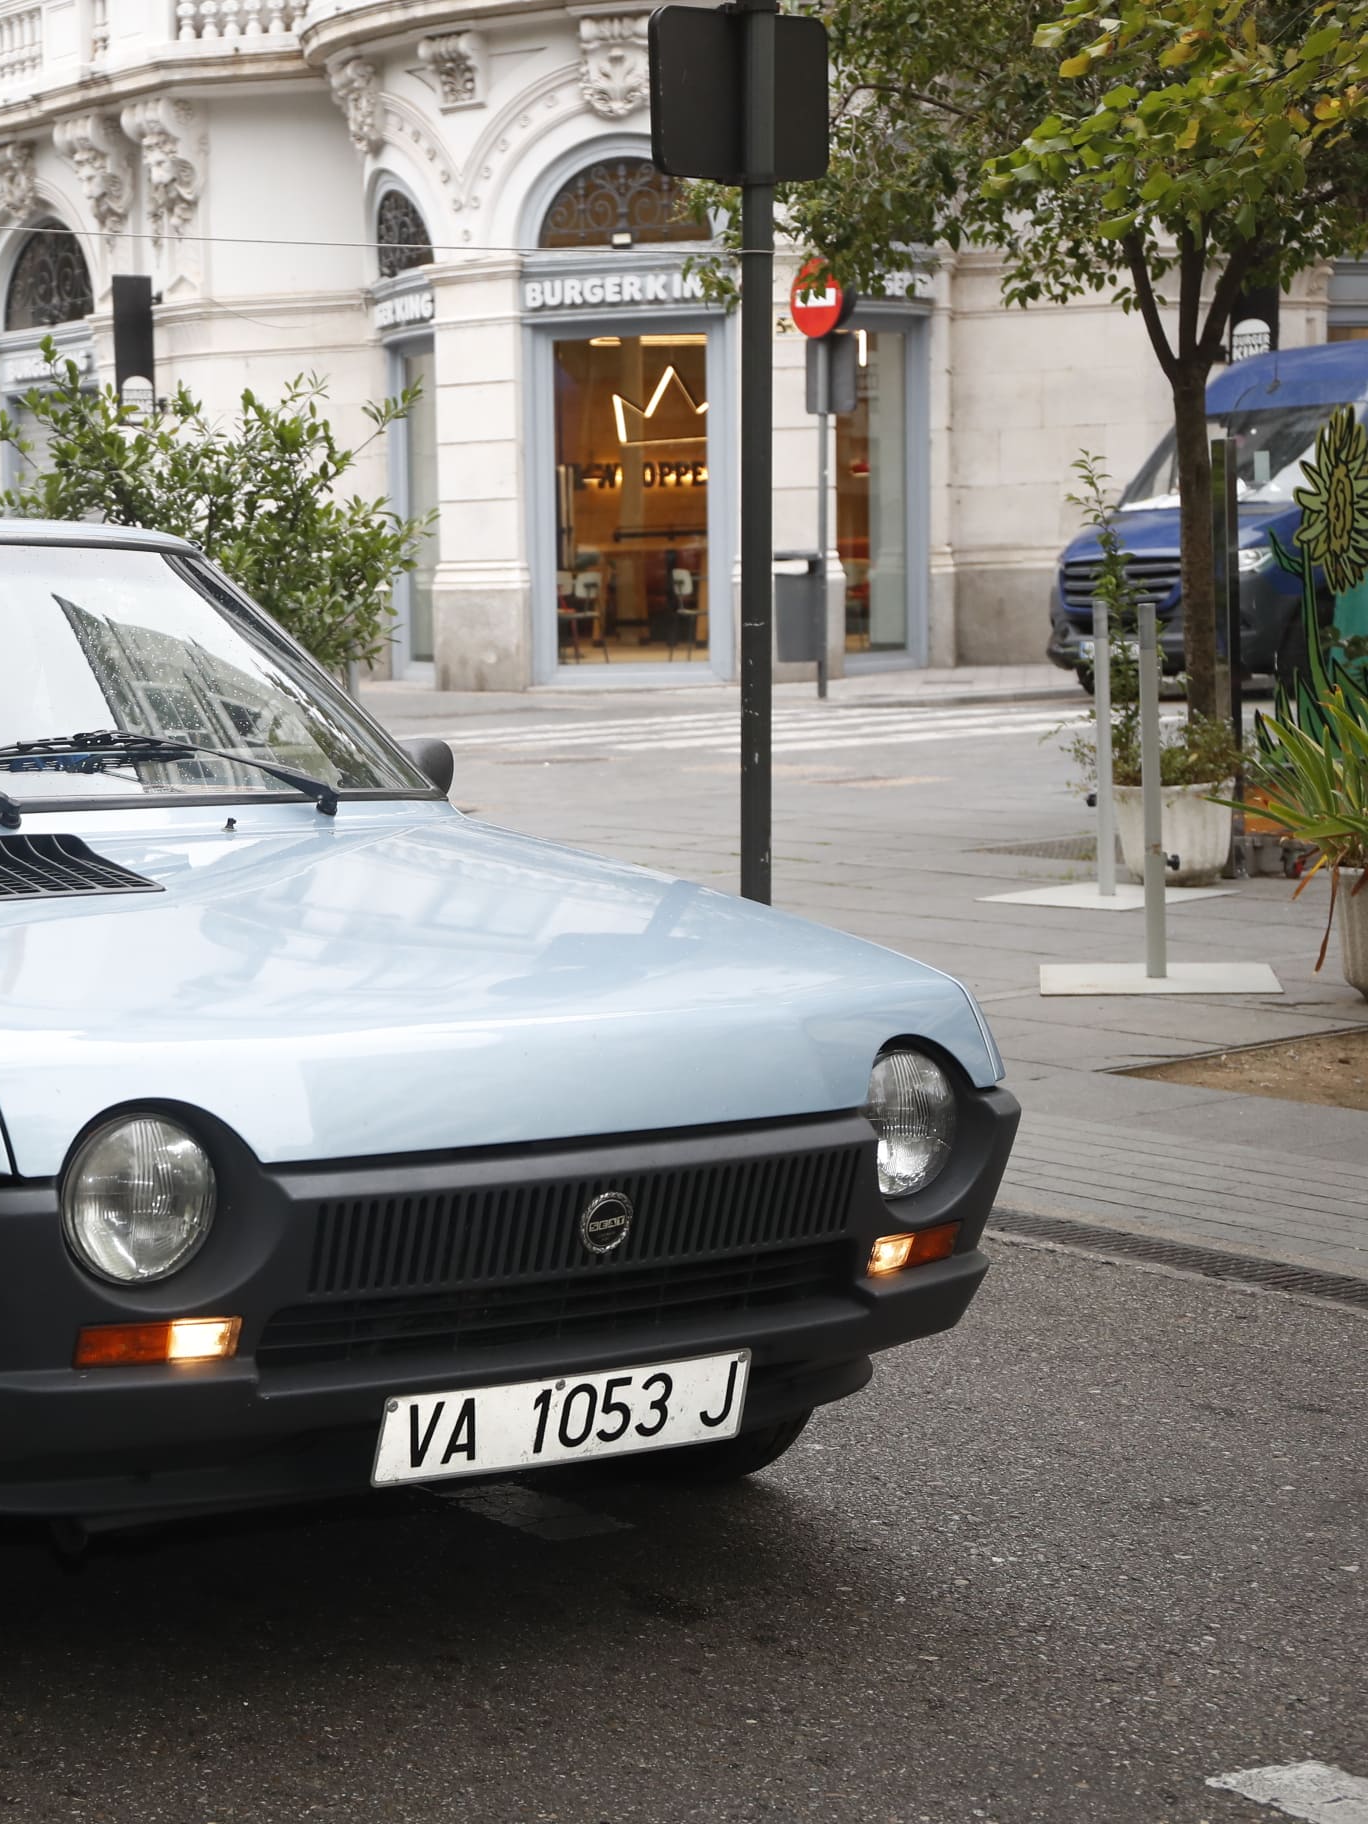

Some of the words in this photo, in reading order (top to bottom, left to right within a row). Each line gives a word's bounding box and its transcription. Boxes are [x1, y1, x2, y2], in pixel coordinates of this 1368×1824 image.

[525, 275, 642, 308] BURGER
[645, 273, 720, 300] KIN
[589, 1215, 626, 1233] SEAT
[409, 1397, 476, 1468] VA
[532, 1372, 673, 1454] 1053
[699, 1360, 739, 1427] J
